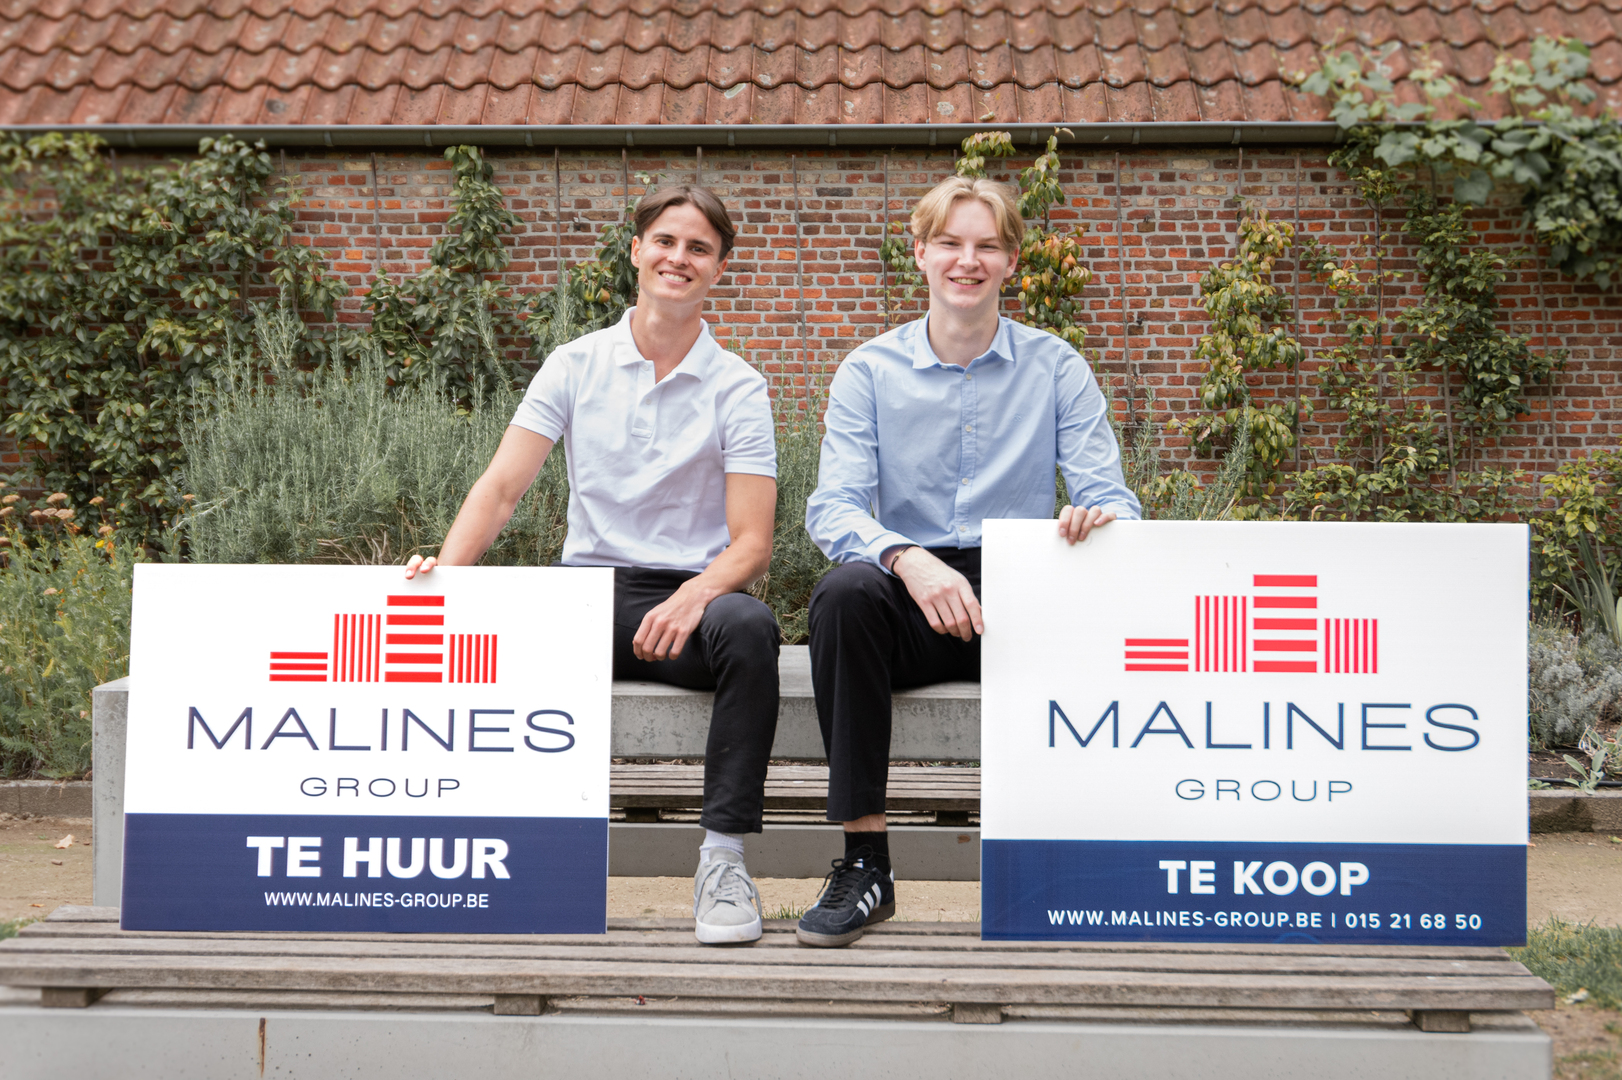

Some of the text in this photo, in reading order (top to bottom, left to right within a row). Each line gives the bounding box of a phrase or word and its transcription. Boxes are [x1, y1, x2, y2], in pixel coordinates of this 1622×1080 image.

[187, 706, 576, 753] MALINES
[1049, 700, 1480, 752] MALINES
[300, 777, 461, 798] GROUP
[1175, 779, 1353, 802] GROUP
[246, 836, 511, 880] TE HUUR
[1158, 860, 1370, 896] TE KOOP
[264, 891, 489, 909] WWW.MALINES-GROUP.BE
[1047, 909, 1322, 929] WWW.MALINES-GROUP.BE
[1345, 912, 1381, 929] 015
[1389, 912, 1412, 929] 21
[1419, 913, 1447, 930] 68
[1455, 913, 1482, 930] 50
